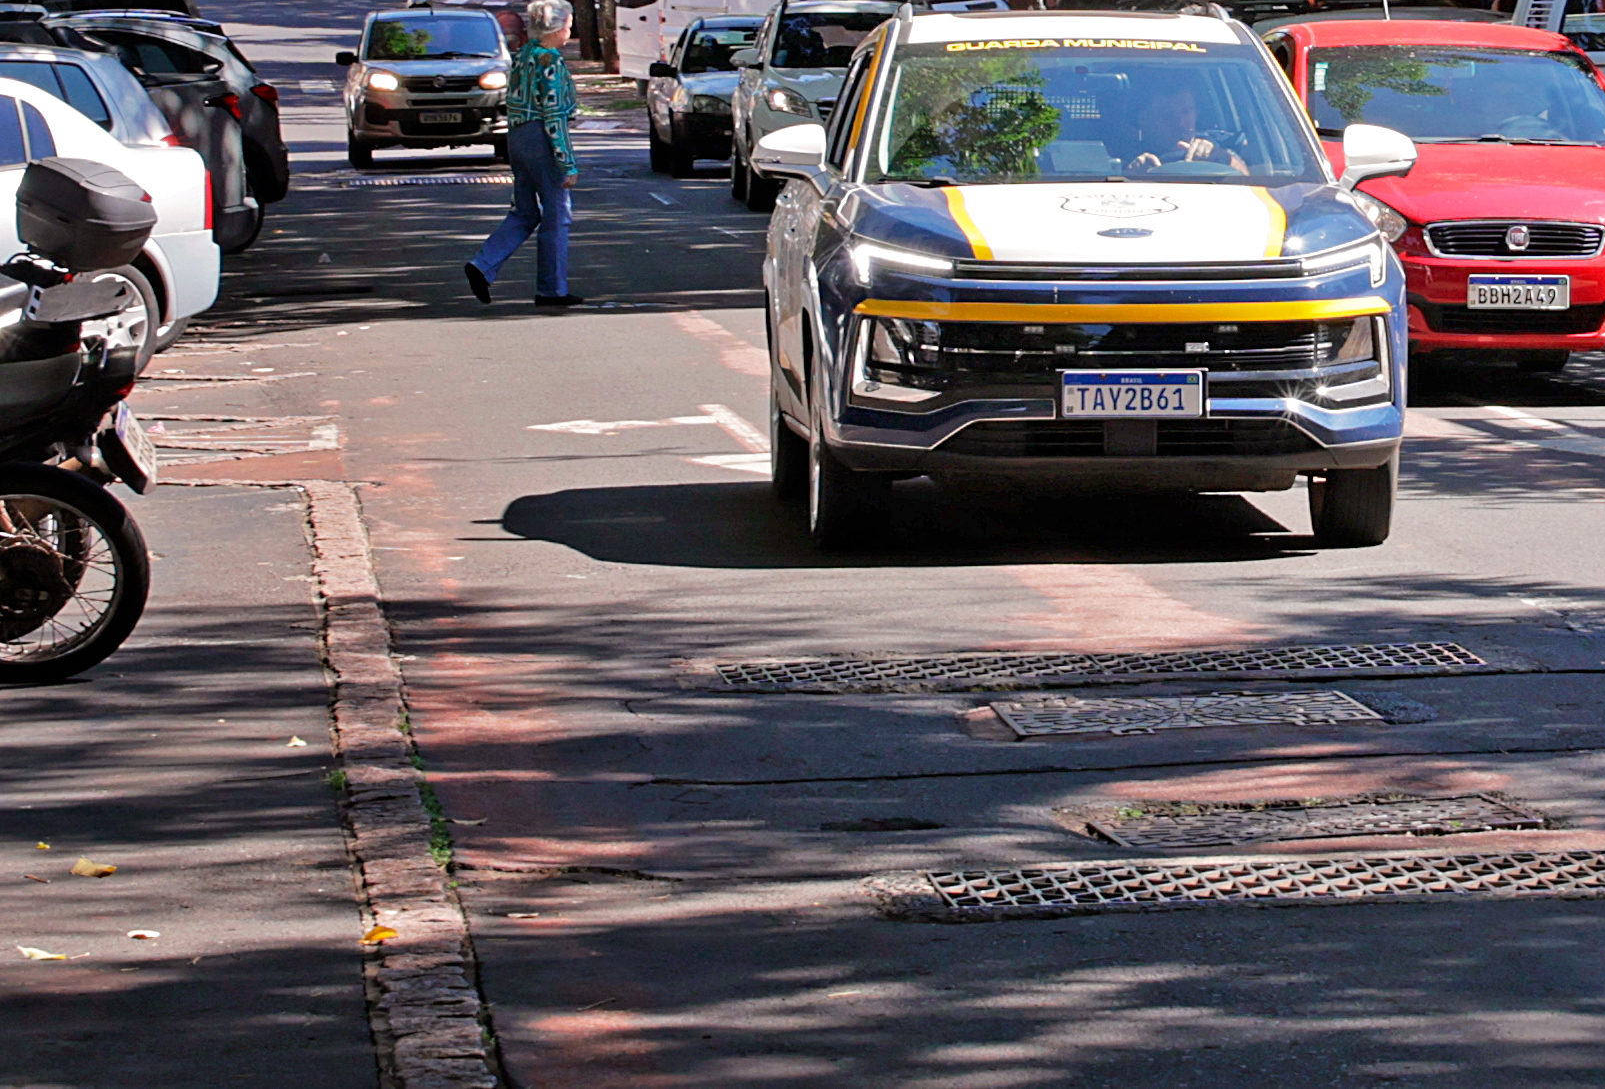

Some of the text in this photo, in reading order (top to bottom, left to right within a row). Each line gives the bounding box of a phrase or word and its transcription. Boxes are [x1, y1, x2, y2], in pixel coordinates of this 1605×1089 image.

[946, 39, 1207, 53] GUARDA MUNICIPAL
[1477, 287, 1557, 305] BBH2A49
[1076, 387, 1185, 411] TAY2B61
